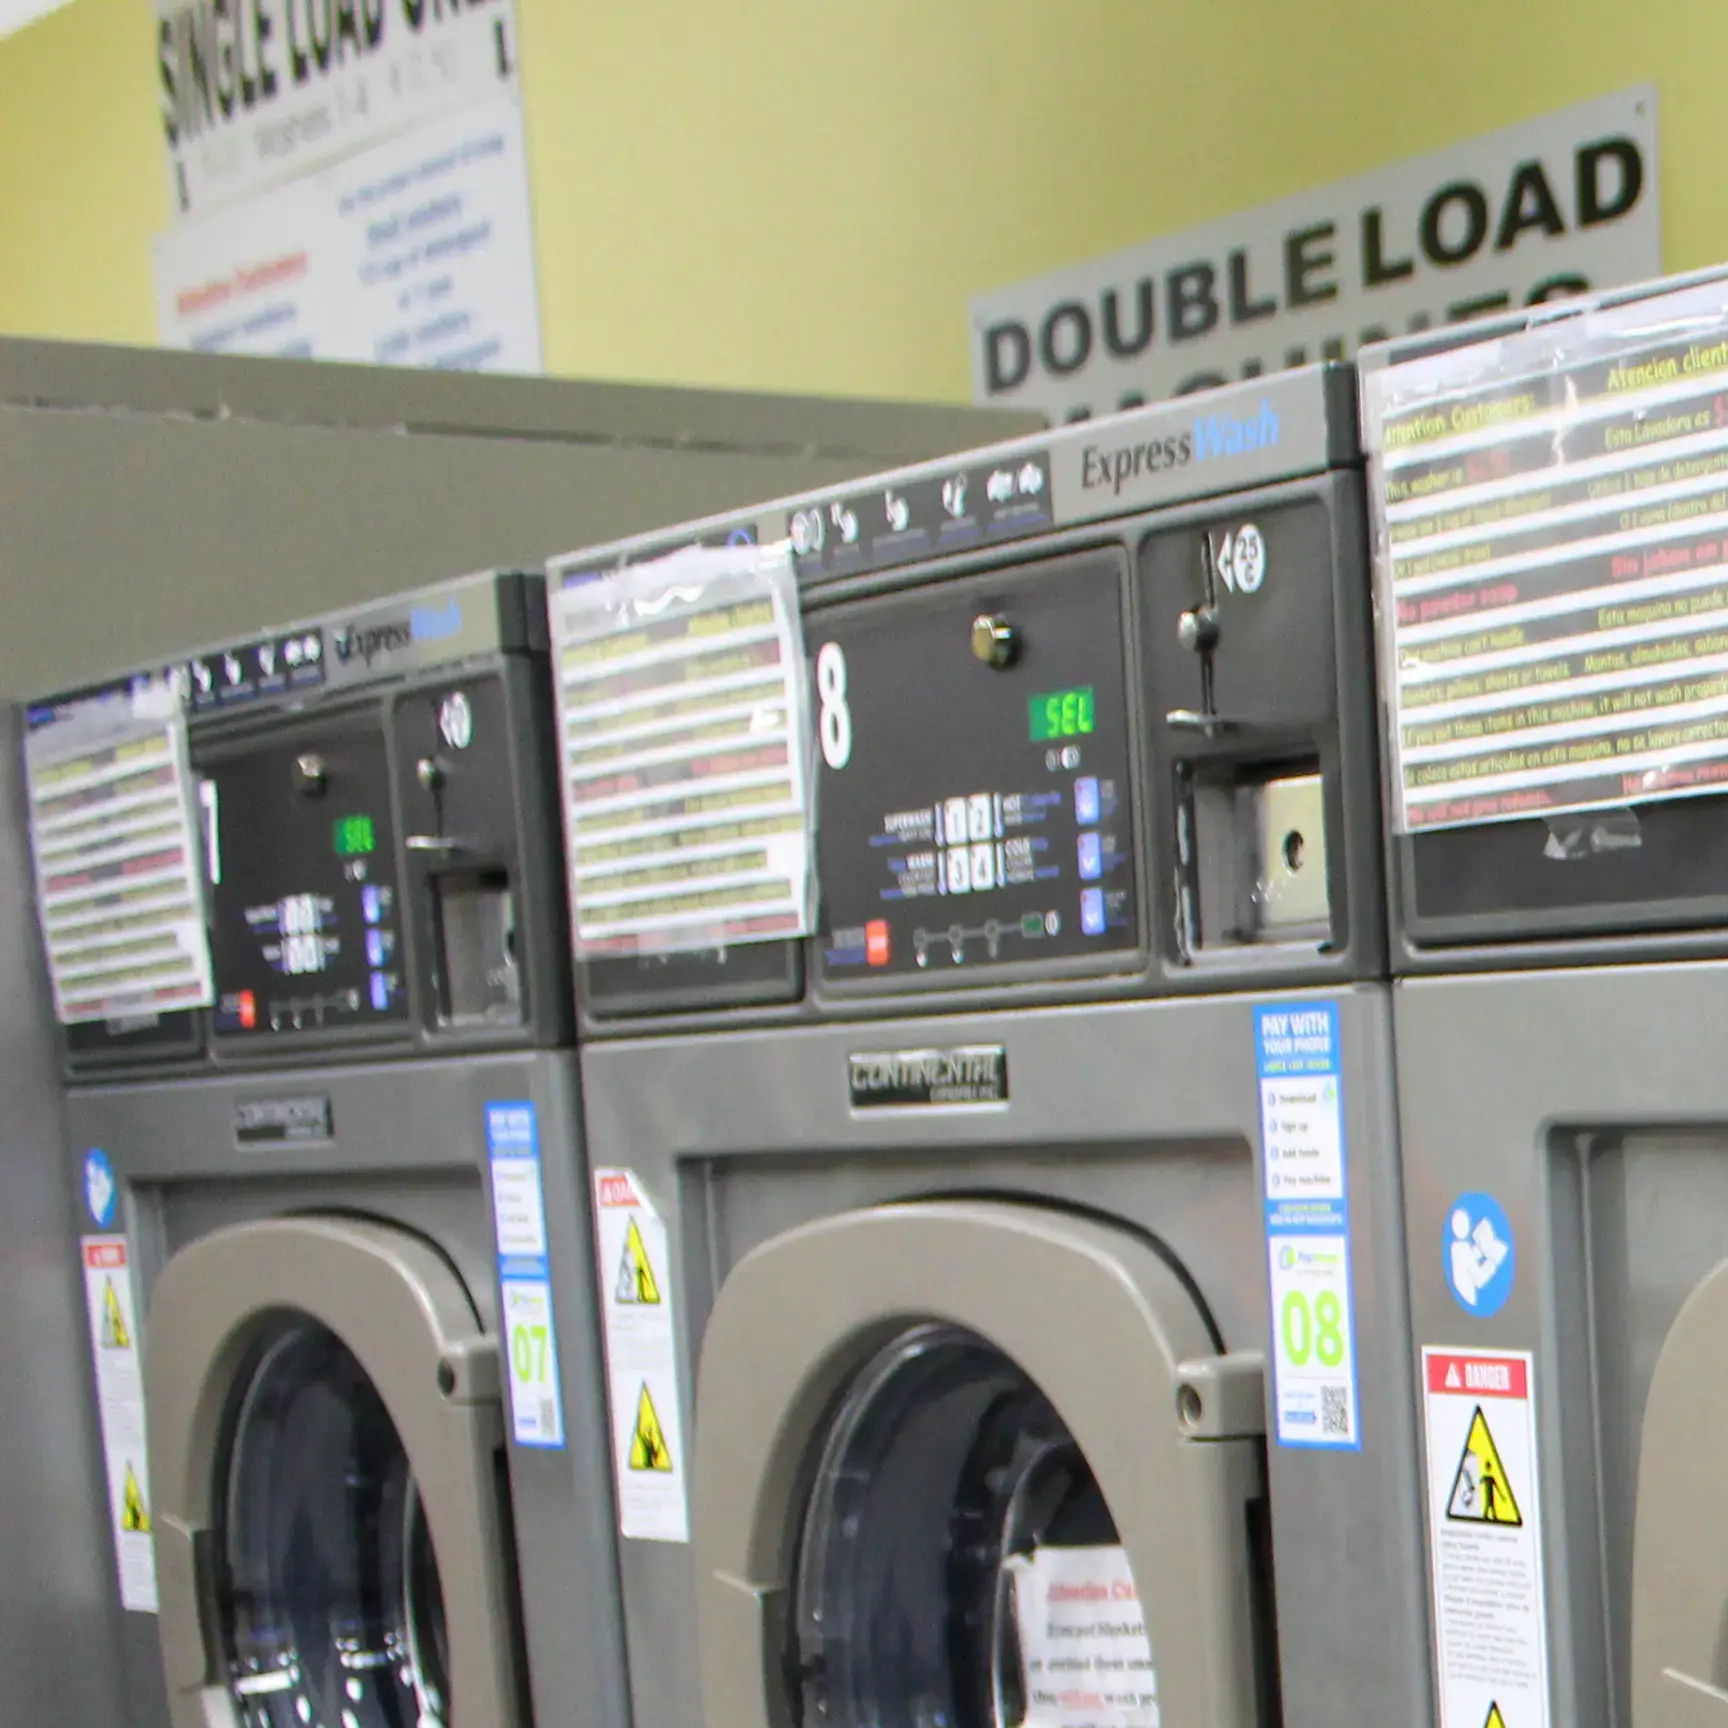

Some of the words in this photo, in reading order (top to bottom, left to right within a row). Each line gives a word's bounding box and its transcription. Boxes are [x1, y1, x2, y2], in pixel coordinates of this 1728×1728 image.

[982, 219, 1340, 396] DOUBLE
[1360, 134, 1645, 289] LOAD
[1240, 536, 1259, 563] 25
[816, 641, 852, 770] 8
[1261, 1013, 1287, 1038] PAY
[1290, 1010, 1329, 1035] WITH
[514, 1324, 548, 1383] 07
[1281, 1289, 1345, 1368] 08
[1465, 1362, 1510, 1391] DANGER
